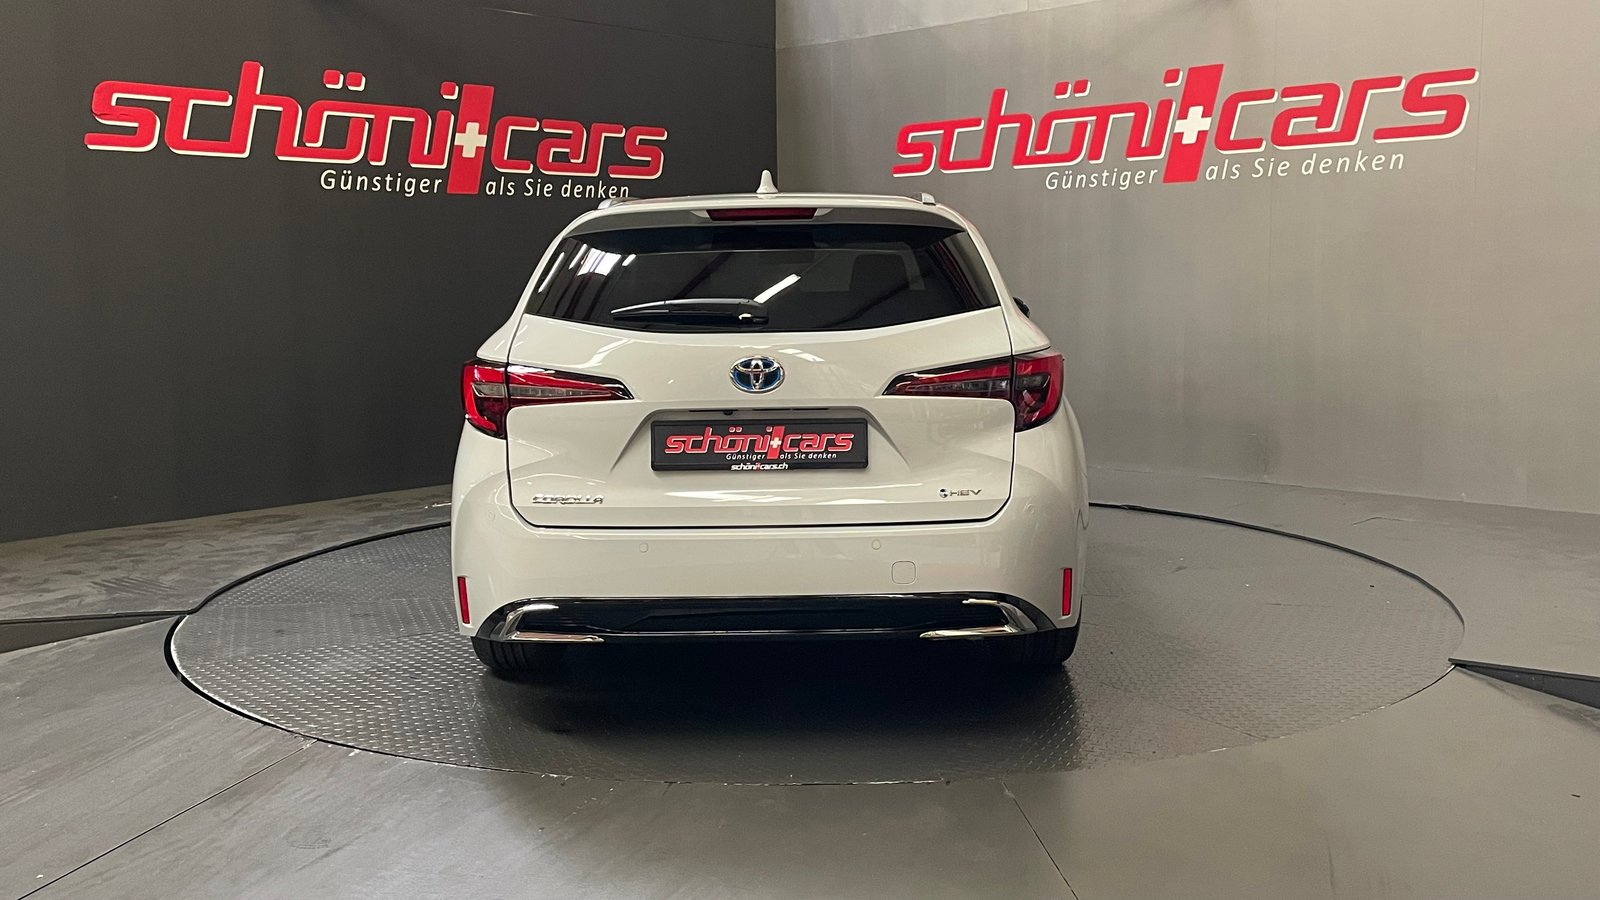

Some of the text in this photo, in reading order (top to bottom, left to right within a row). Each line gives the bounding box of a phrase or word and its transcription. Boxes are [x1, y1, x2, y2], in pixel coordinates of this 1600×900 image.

[1045, 151, 1404, 190] Günstiger als Sie denken
[320, 169, 630, 199] Günstiger als Sie denken
[726, 452, 837, 461] Günstiger als Sie denken
[950, 489, 982, 497] HEV
[532, 494, 604, 505] COROLLA
